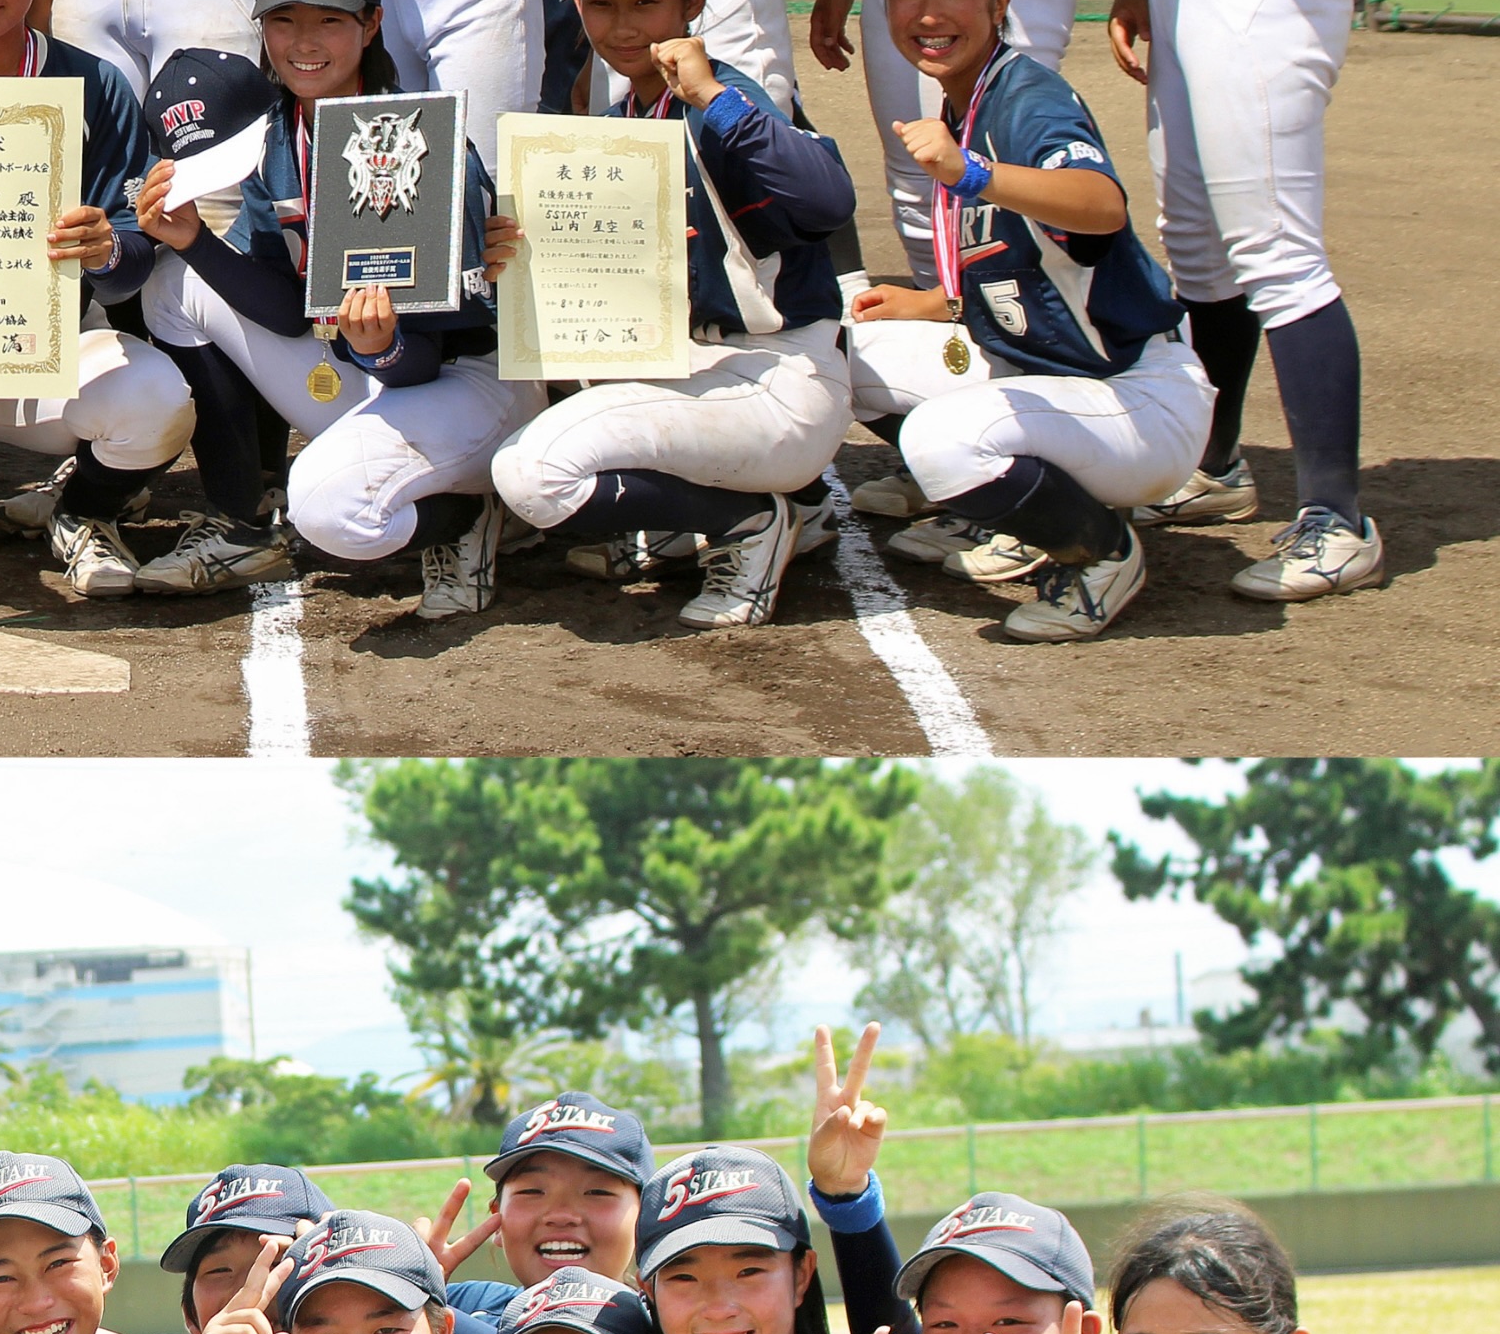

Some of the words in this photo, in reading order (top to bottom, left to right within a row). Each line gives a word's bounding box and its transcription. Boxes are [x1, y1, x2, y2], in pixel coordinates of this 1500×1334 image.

[161, 99, 206, 137] MVP
[556, 164, 625, 182] 表彰状
[16, 191, 39, 208] 殿
[539, 189, 594, 201] 最優秀選手賞
[545, 209, 588, 220] 5START
[981, 279, 1027, 336] 5
[518, 1101, 615, 1144] 5START
[194, 1178, 284, 1224] 5START
[658, 1167, 759, 1221] 5START
[932, 1203, 1034, 1246] 5START
[297, 1228, 396, 1279] 5START
[516, 1278, 618, 1325] 5START
